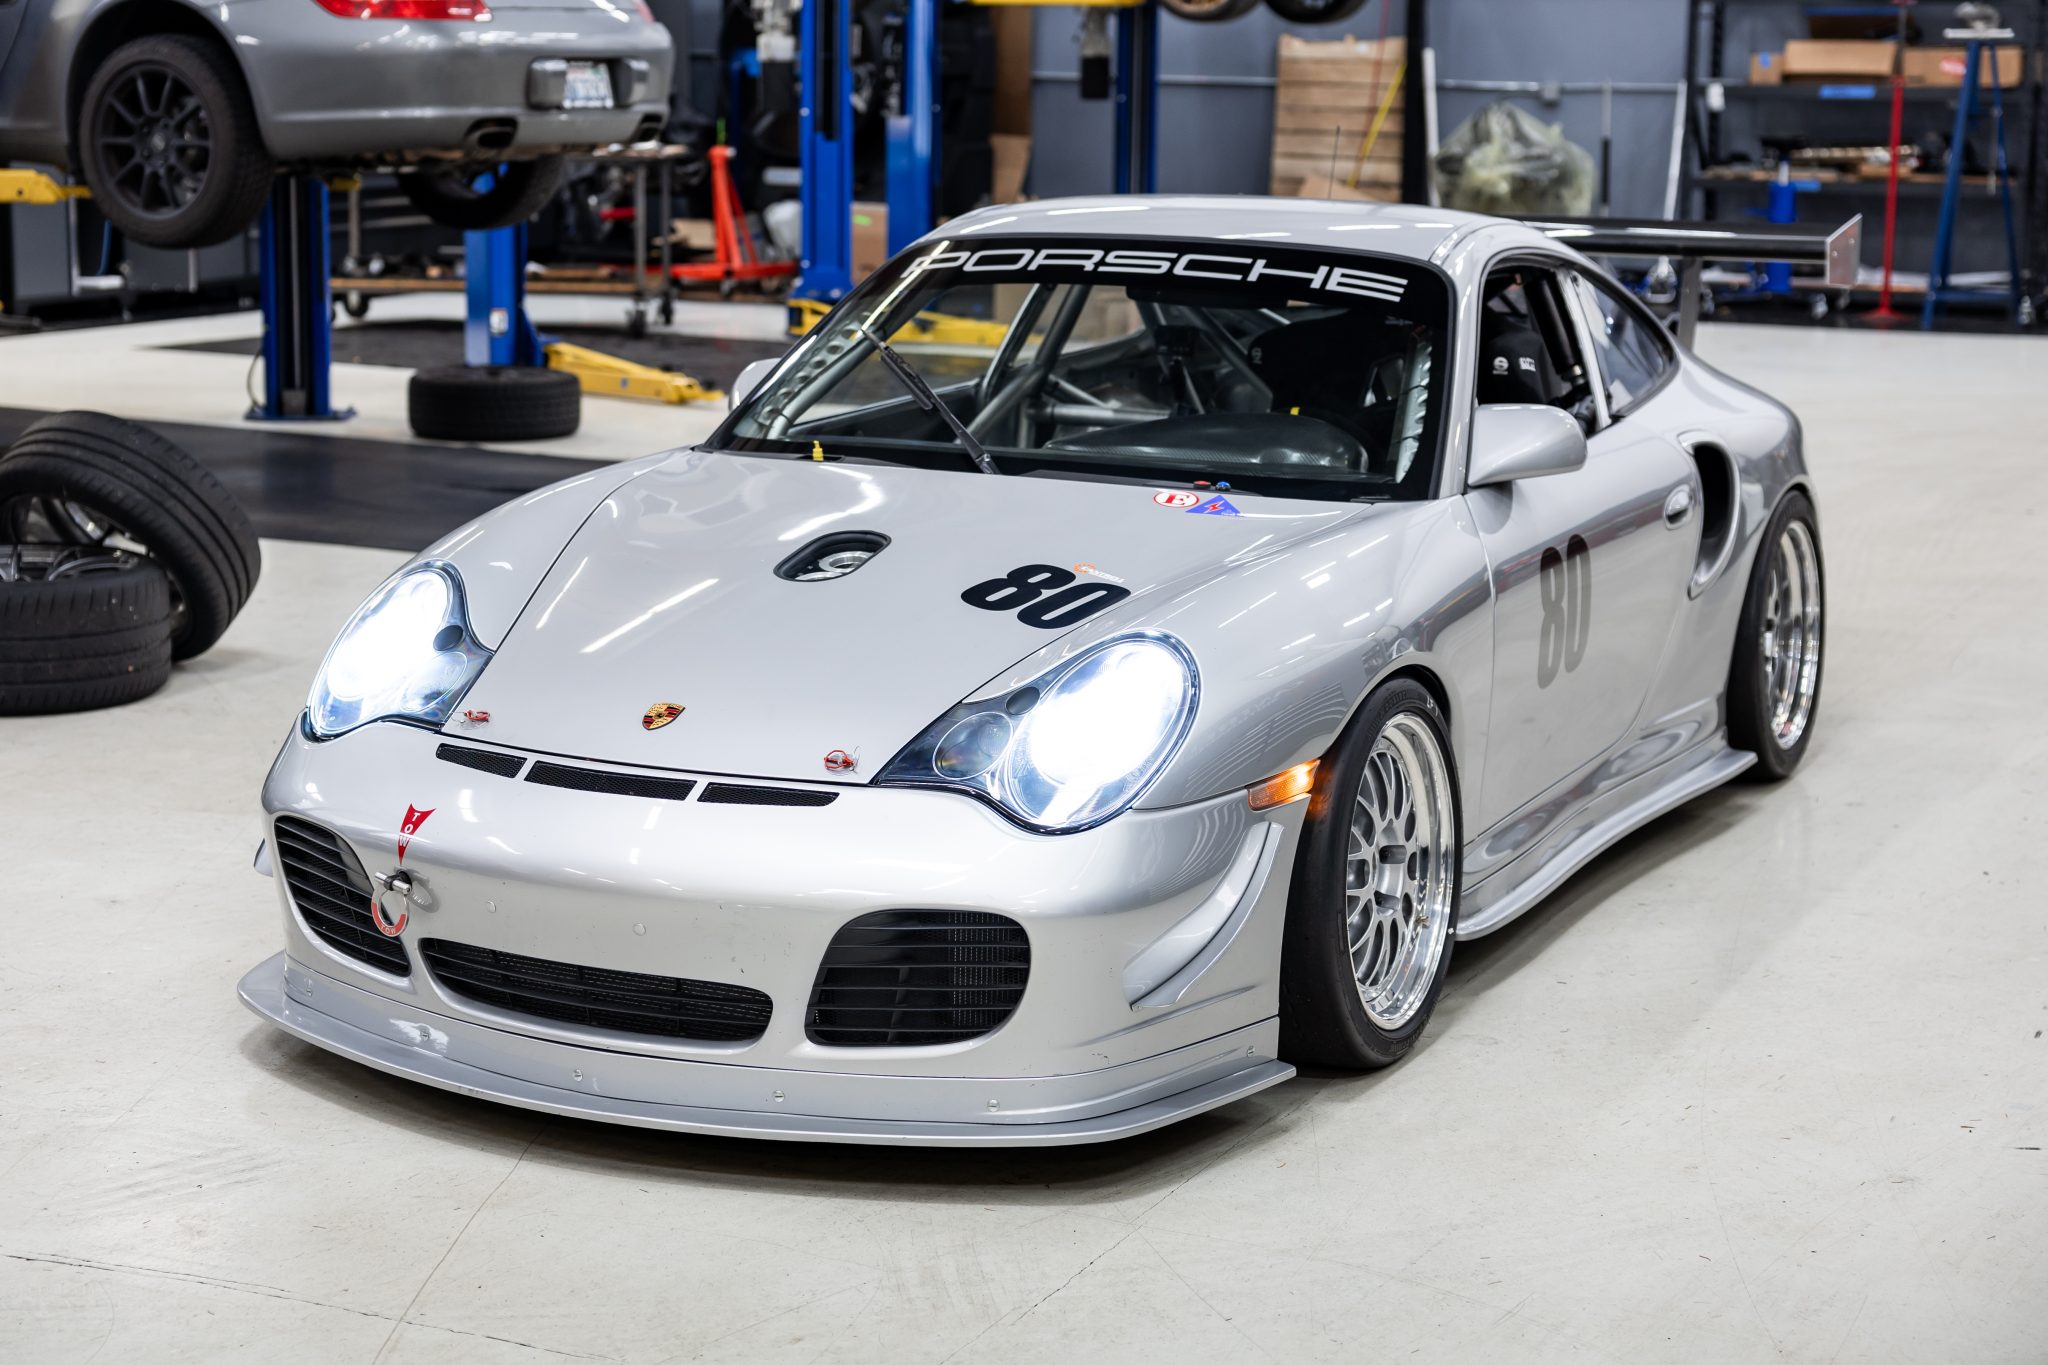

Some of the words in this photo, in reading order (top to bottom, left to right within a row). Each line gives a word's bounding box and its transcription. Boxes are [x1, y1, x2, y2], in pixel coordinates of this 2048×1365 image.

[900, 248, 1408, 302] PORSCHE
[961, 564, 1131, 629] 80
[1537, 534, 1592, 690] 80
[400, 812, 421, 848] TOW
[381, 924, 396, 935] TOW
